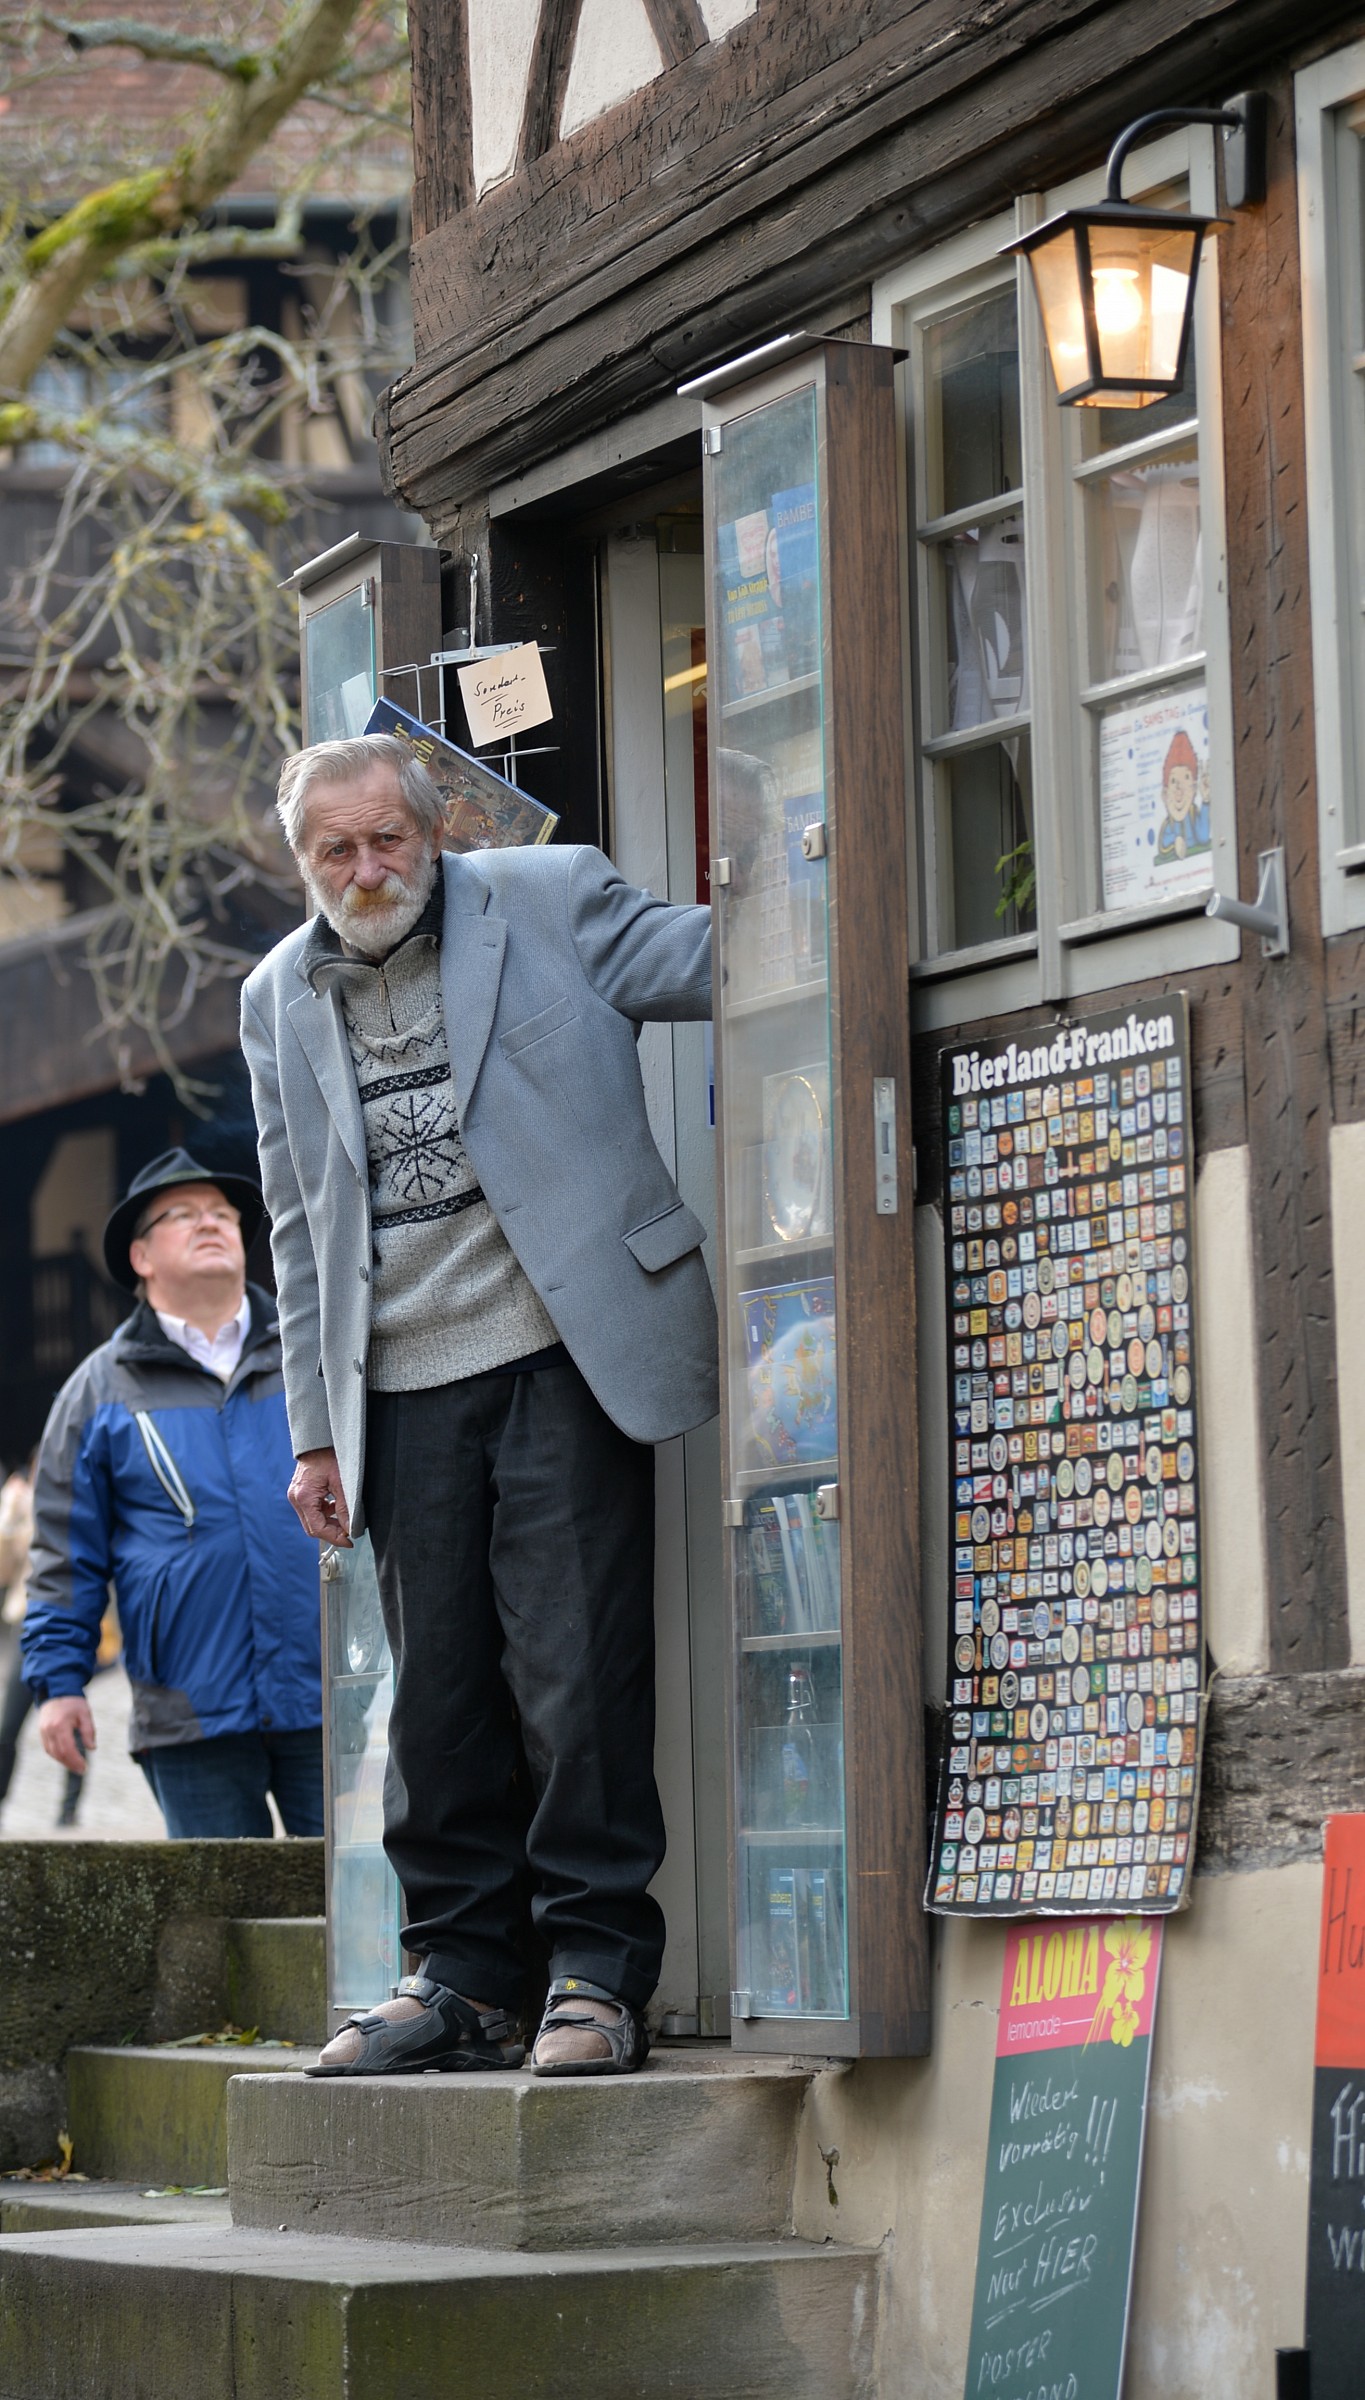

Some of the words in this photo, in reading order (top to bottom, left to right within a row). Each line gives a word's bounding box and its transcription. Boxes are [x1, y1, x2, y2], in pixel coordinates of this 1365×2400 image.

[492, 699, 526, 722] Preis
[952, 1013, 1175, 1096] Bierland-Franken
[1009, 1924, 1100, 2007] ALOHA
[1007, 2015, 1061, 2042] lemonade
[1032, 2233, 1098, 2288] HIER
